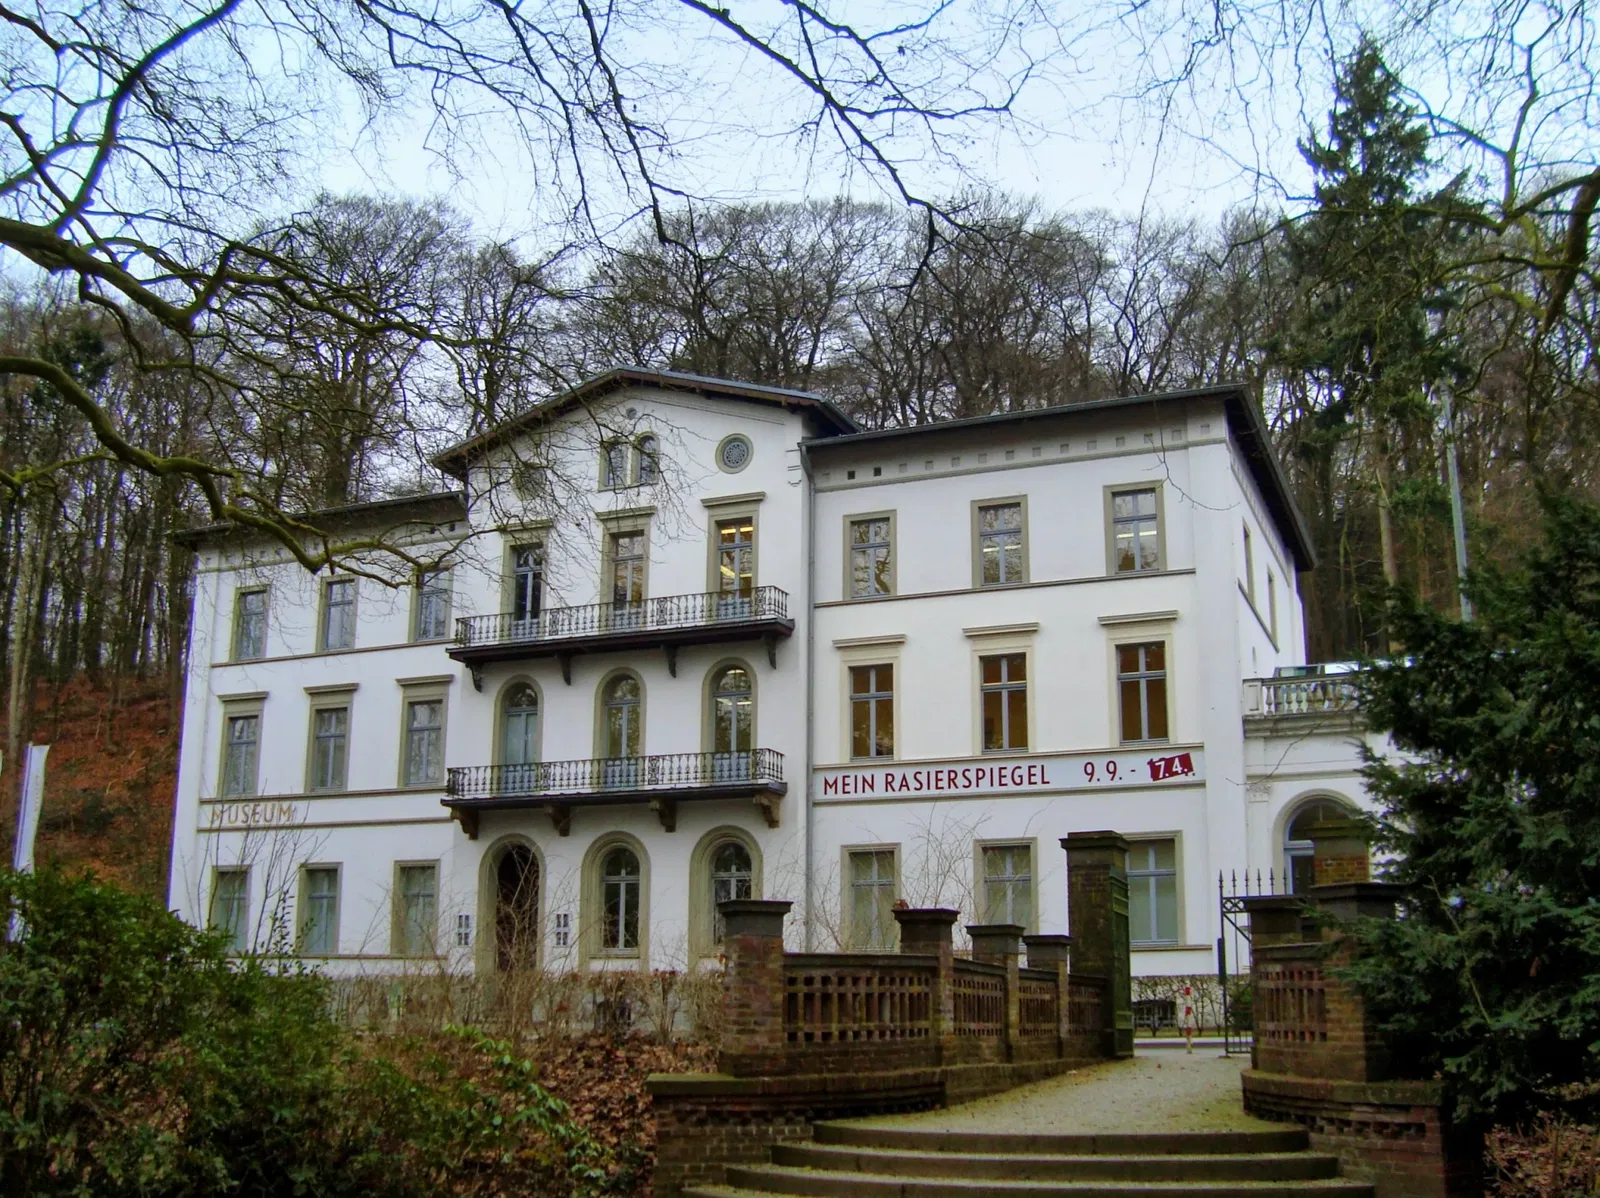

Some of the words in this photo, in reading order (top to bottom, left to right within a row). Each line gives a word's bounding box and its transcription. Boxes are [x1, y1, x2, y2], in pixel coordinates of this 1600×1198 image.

[824, 774, 875, 795] MEIN
[884, 764, 1050, 792] RASIERSPIEGEL
[211, 803, 293, 824] MUSEUM
